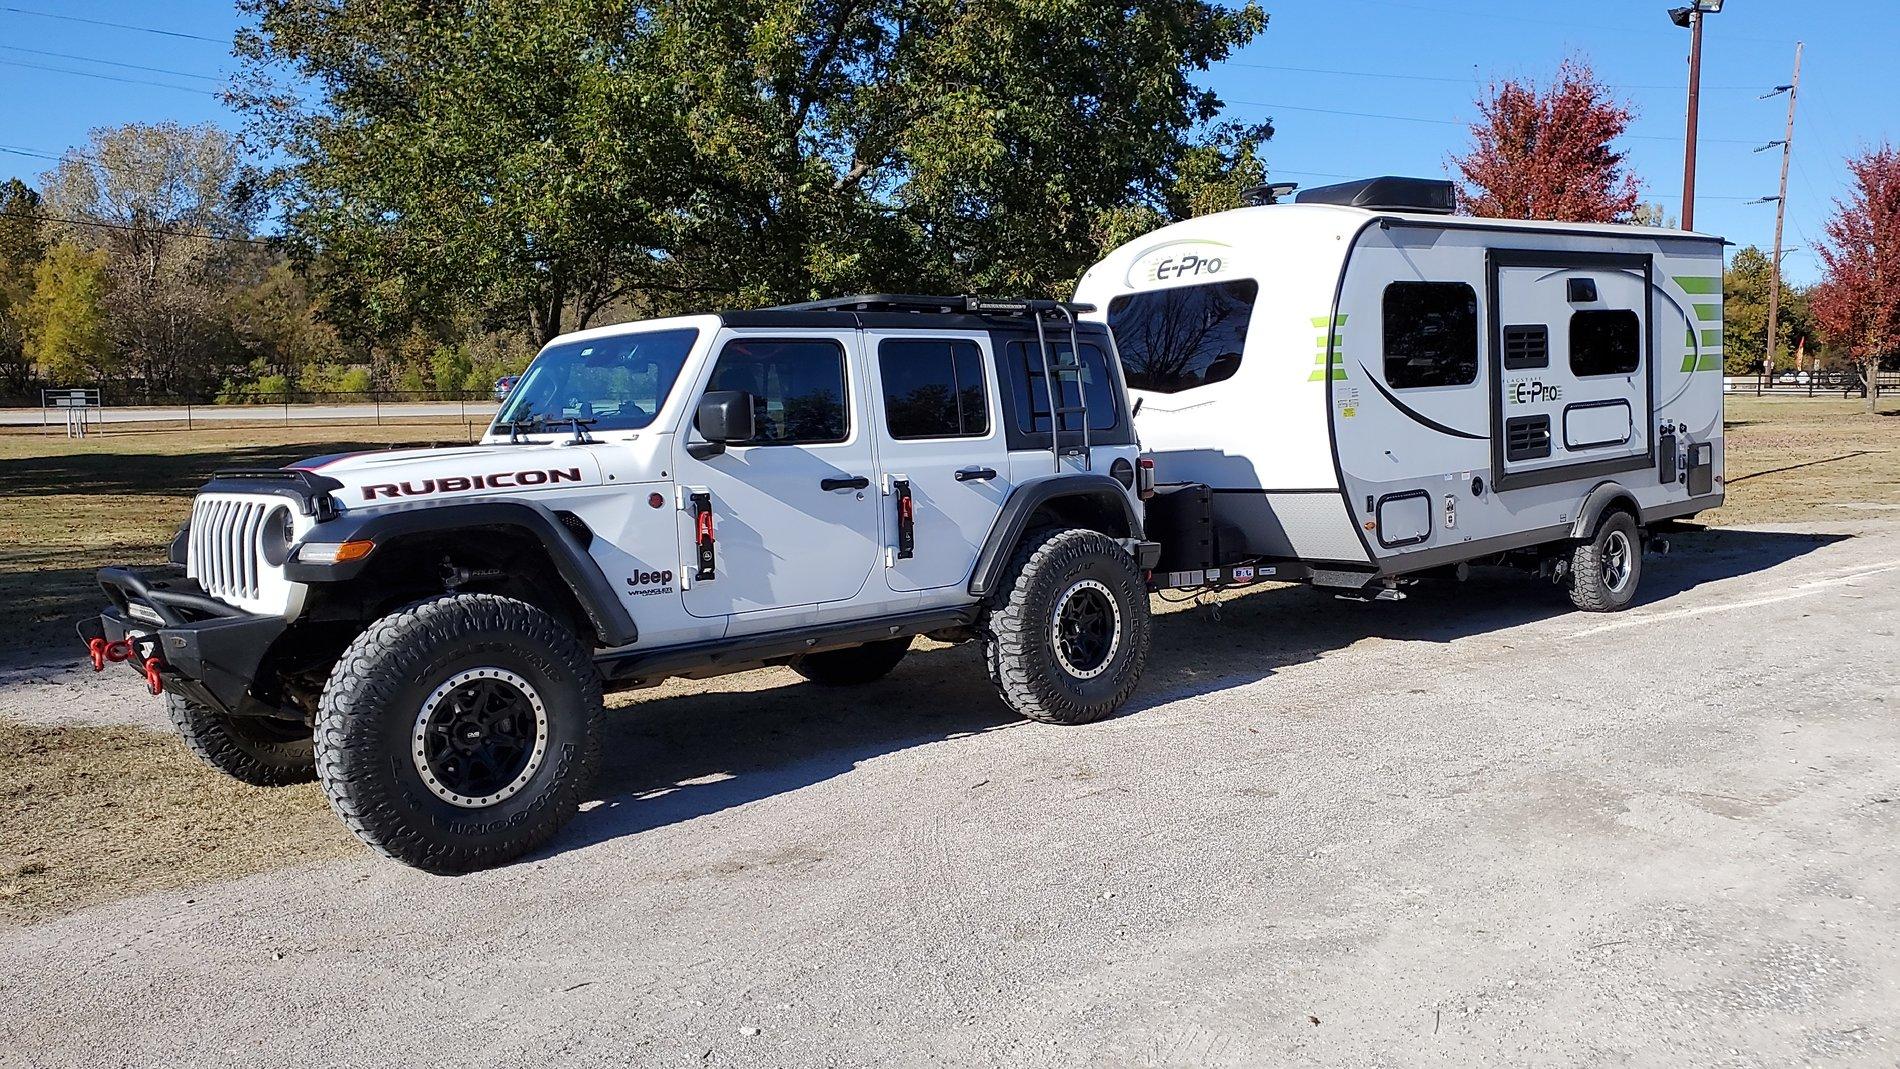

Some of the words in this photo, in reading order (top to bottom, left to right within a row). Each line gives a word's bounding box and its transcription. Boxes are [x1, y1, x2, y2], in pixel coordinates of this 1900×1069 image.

[1157, 255, 1222, 280] E-Pro
[1516, 381, 1558, 404] E-Pro
[361, 467, 582, 500] RUBICON
[627, 569, 673, 585] Jeep
[628, 587, 673, 596] WRANGLER
